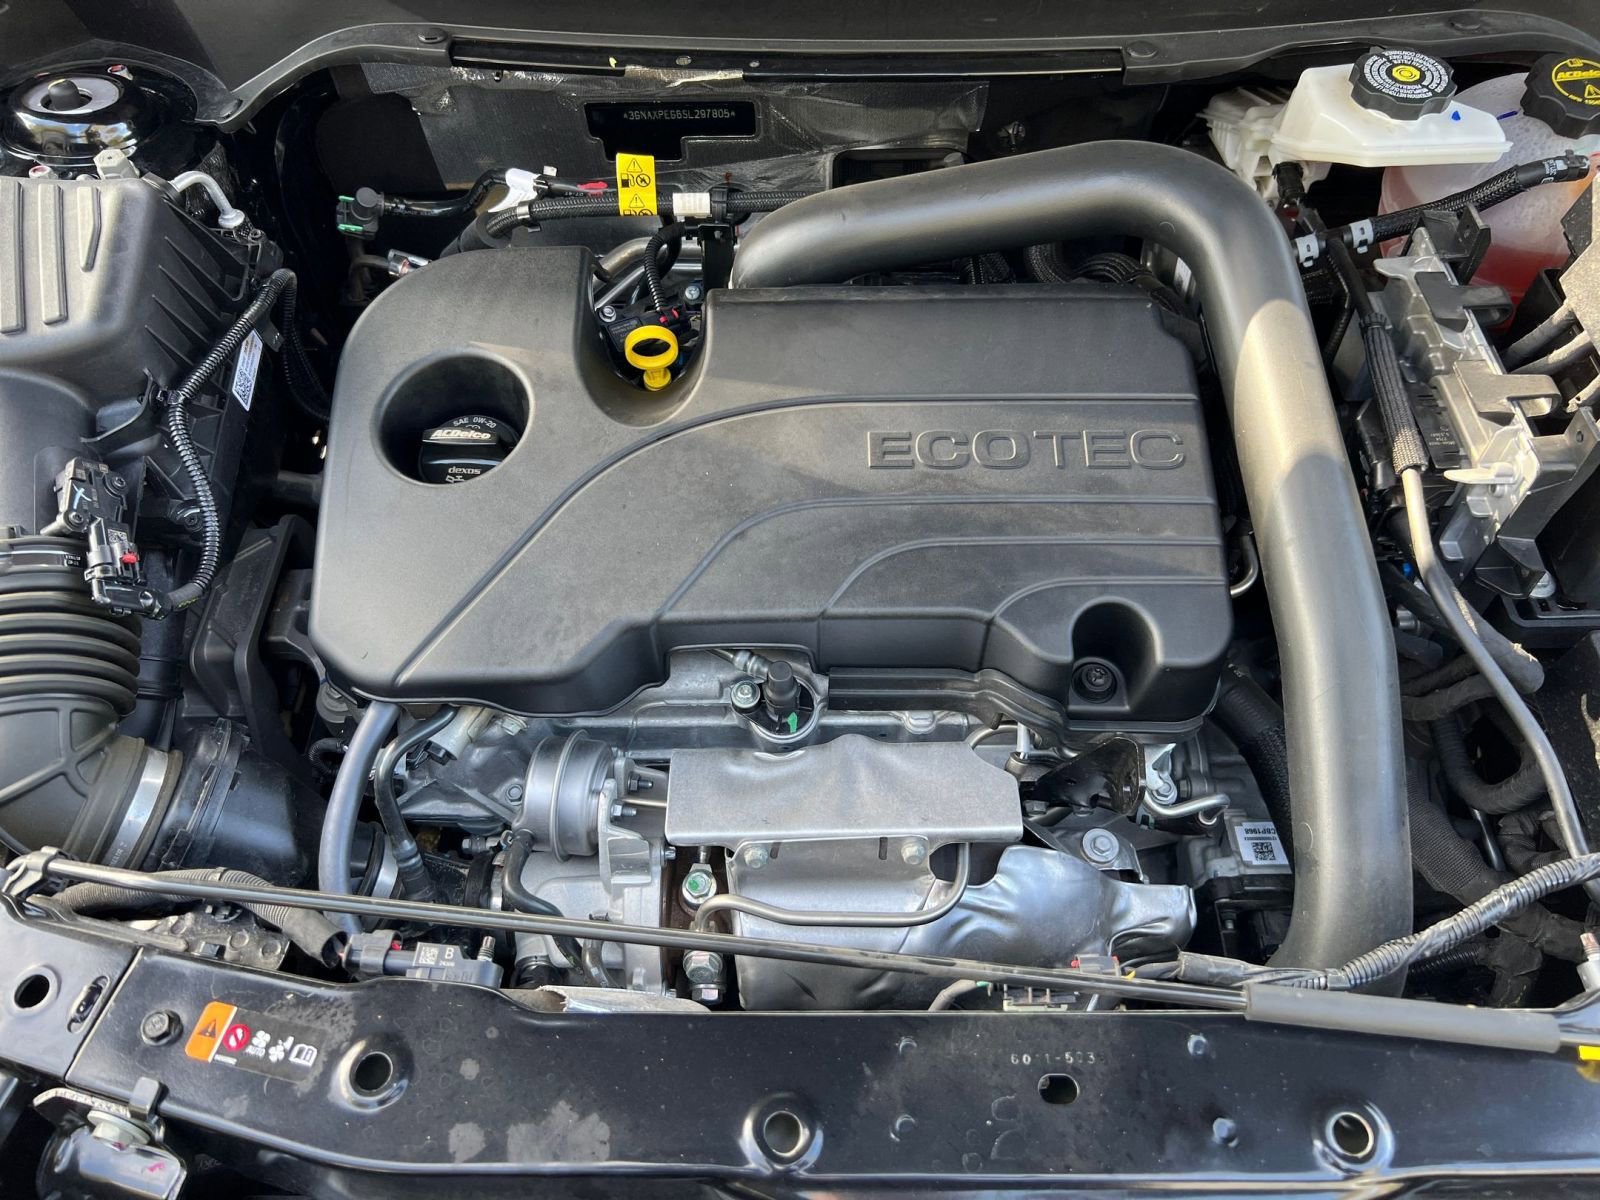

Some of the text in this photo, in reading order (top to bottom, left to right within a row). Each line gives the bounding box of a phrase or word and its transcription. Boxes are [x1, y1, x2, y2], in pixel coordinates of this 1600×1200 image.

[453, 417, 469, 427] SAE
[430, 430, 491, 440] ACDelco
[867, 429, 1185, 470] ECOTEC
[448, 466, 481, 475] dexos
[445, 947, 455, 960] B
